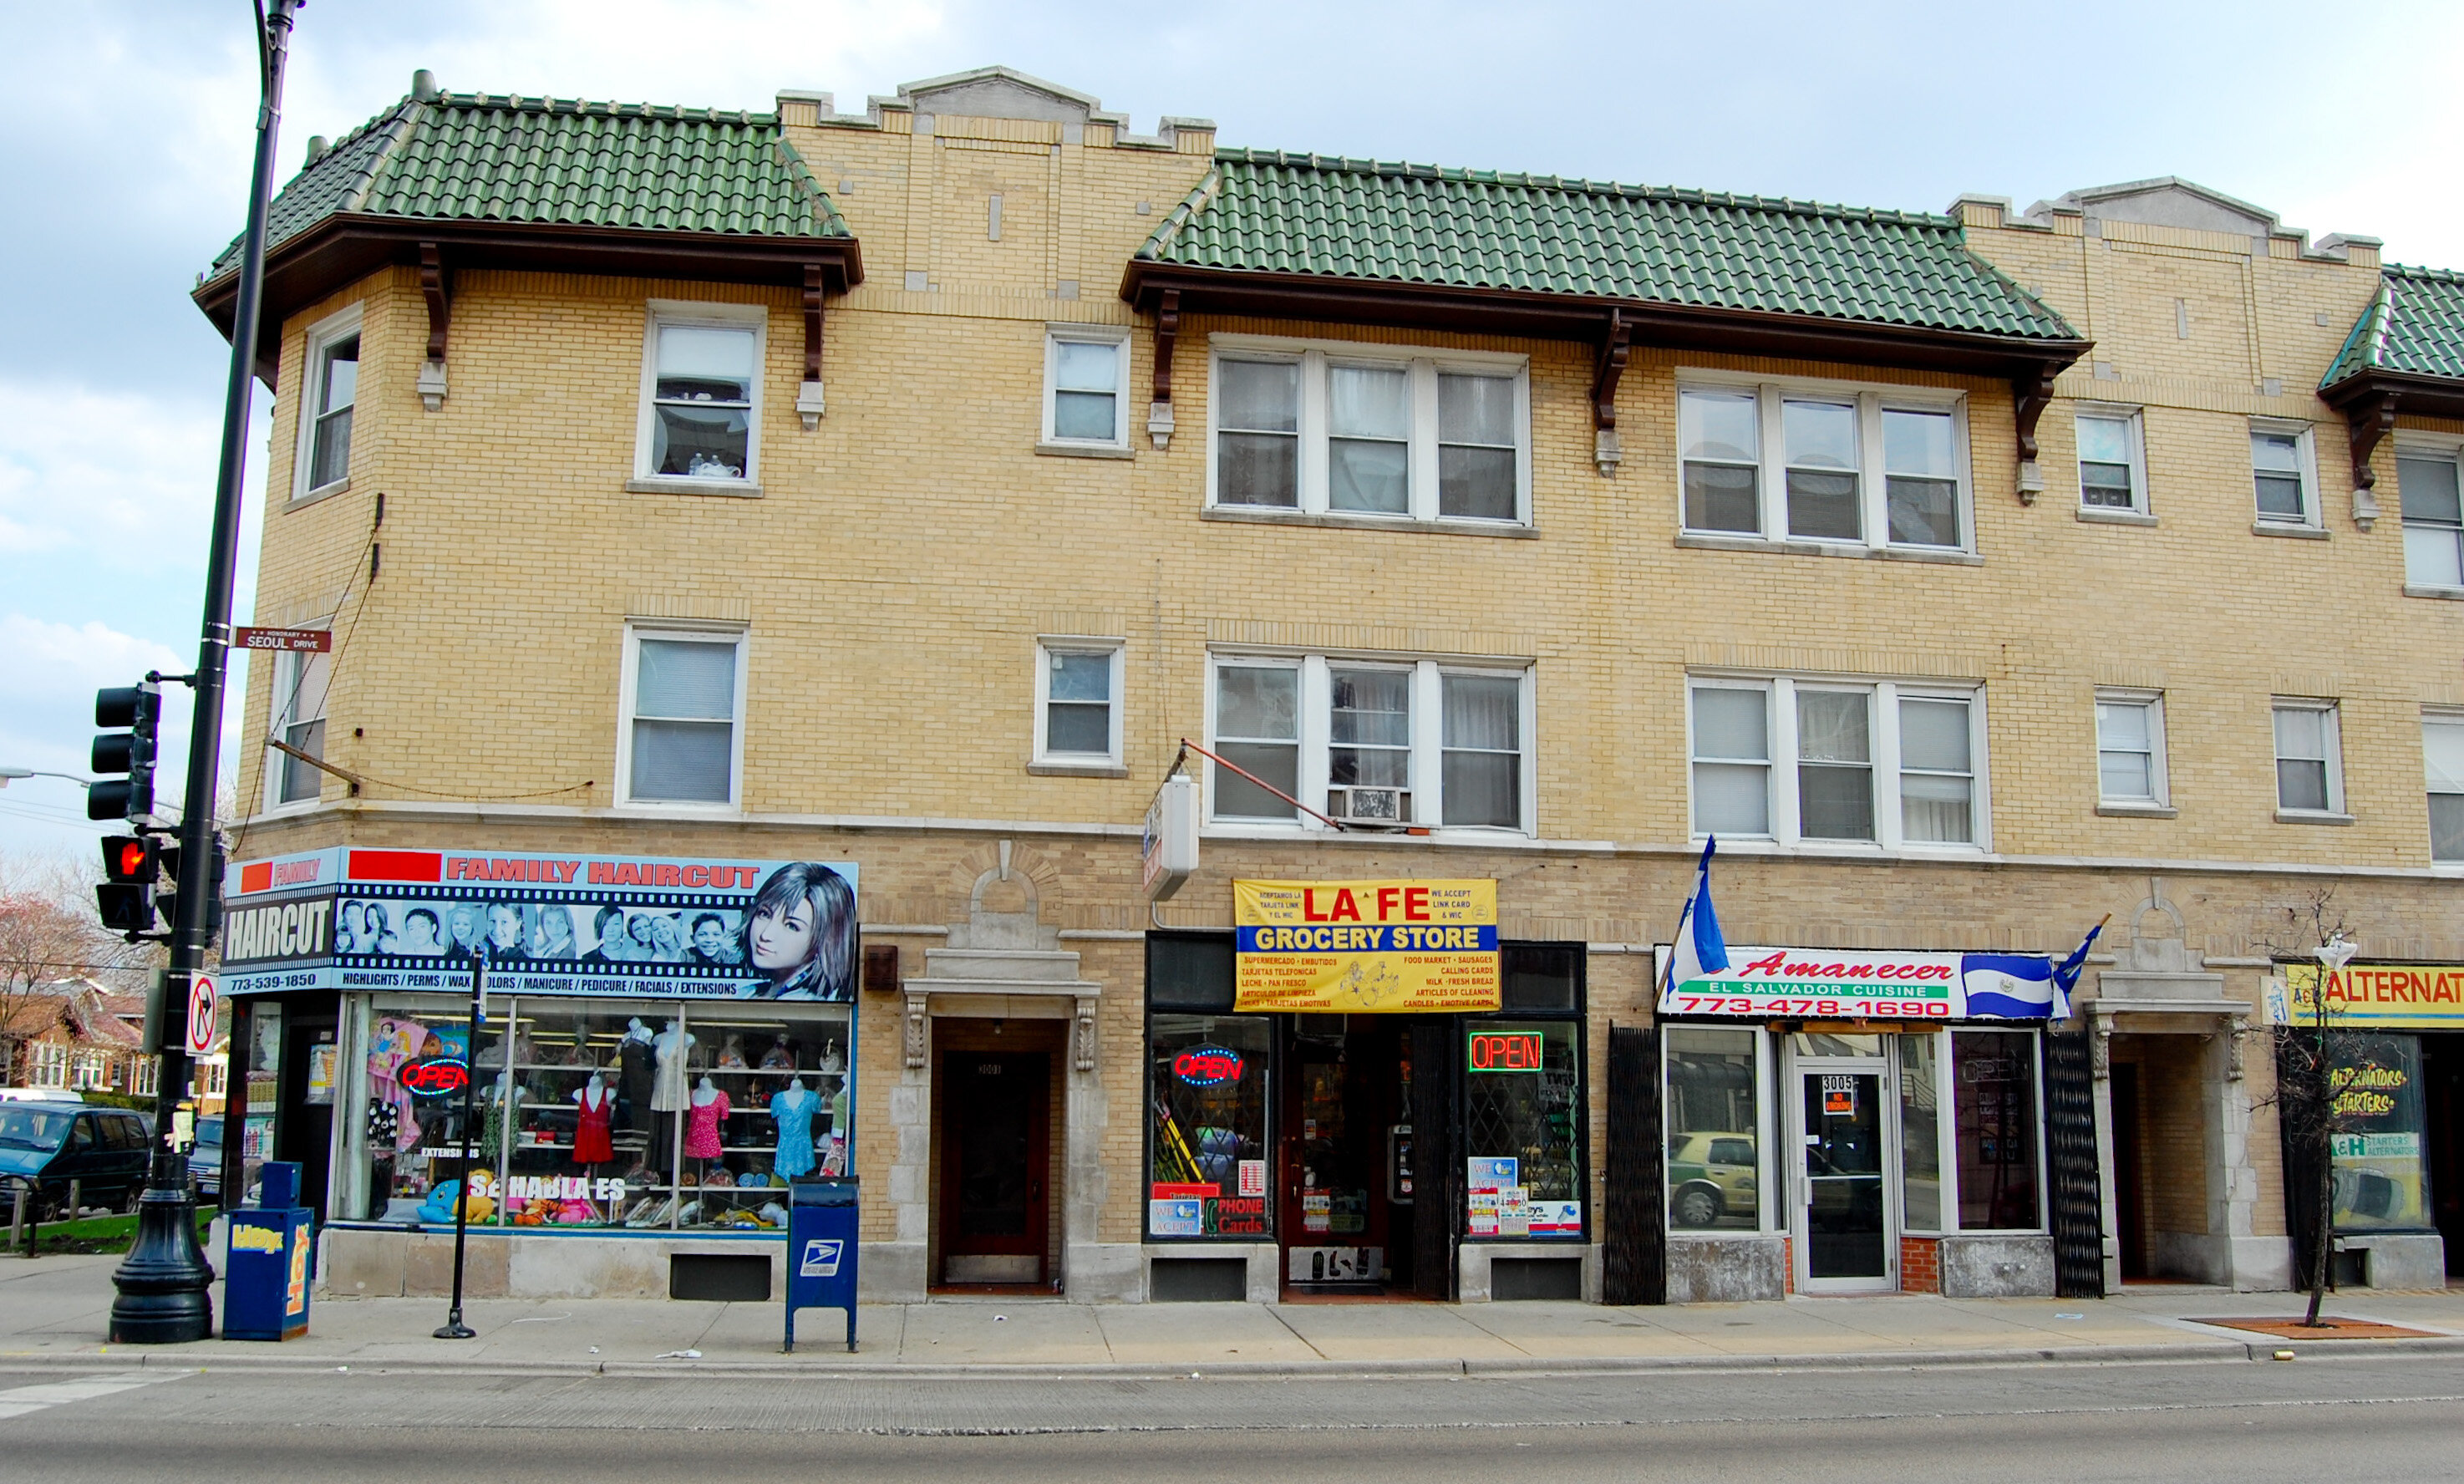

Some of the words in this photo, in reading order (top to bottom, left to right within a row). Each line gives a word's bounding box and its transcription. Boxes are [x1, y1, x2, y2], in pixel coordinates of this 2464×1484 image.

[247, 636, 288, 648] SEOUL
[293, 640, 318, 648] DRIVE
[274, 858, 321, 887] FAMILY
[447, 857, 581, 883] FAMILY
[588, 861, 760, 888] HAIRCUT
[1303, 888, 1362, 922] LA
[1378, 887, 1430, 921] FE
[226, 900, 330, 961] HAIRCUT
[1255, 927, 1384, 949] GROCERY
[1392, 927, 1480, 949] STORE
[1738, 951, 1953, 979] Amanecer
[231, 973, 317, 991] 773-539-1850
[343, 973, 399, 986] HIGHLIGHTS
[408, 974, 440, 987] PERMS
[448, 975, 470, 988] WAX
[487, 976, 516, 989] OLORS
[525, 978, 573, 990] MANICURE
[582, 979, 627, 992] PEDICURE
[635, 981, 672, 994] FACIALS
[681, 982, 737, 994] EXTENSIONS
[1710, 983, 1731, 993] EL
[1742, 983, 1842, 995] SALVADOR
[1852, 985, 1927, 996] CUISINE
[1679, 997, 1949, 1016] 773-478-1690
[1472, 1036, 1540, 1068] OPEN
[1176, 1054, 1242, 1080] OPEN
[1824, 1076, 1852, 1090] 3005
[1833, 1093, 1843, 1101] NO
[2332, 1090, 2390, 1115] STARTERS
[2367, 1137, 2408, 1146] STARTERS
[2367, 1146, 2420, 1156] ALTERNATORS
[1475, 1164, 1491, 1173] WE
[470, 1175, 500, 1198] SE
[509, 1176, 591, 1199] HABLA
[596, 1178, 625, 1201] ES
[1156, 1207, 1173, 1217] WE
[1218, 1199, 1264, 1213] PHONE
[1156, 1222, 1195, 1232] ACEPT
[1219, 1217, 1262, 1233] Cards
